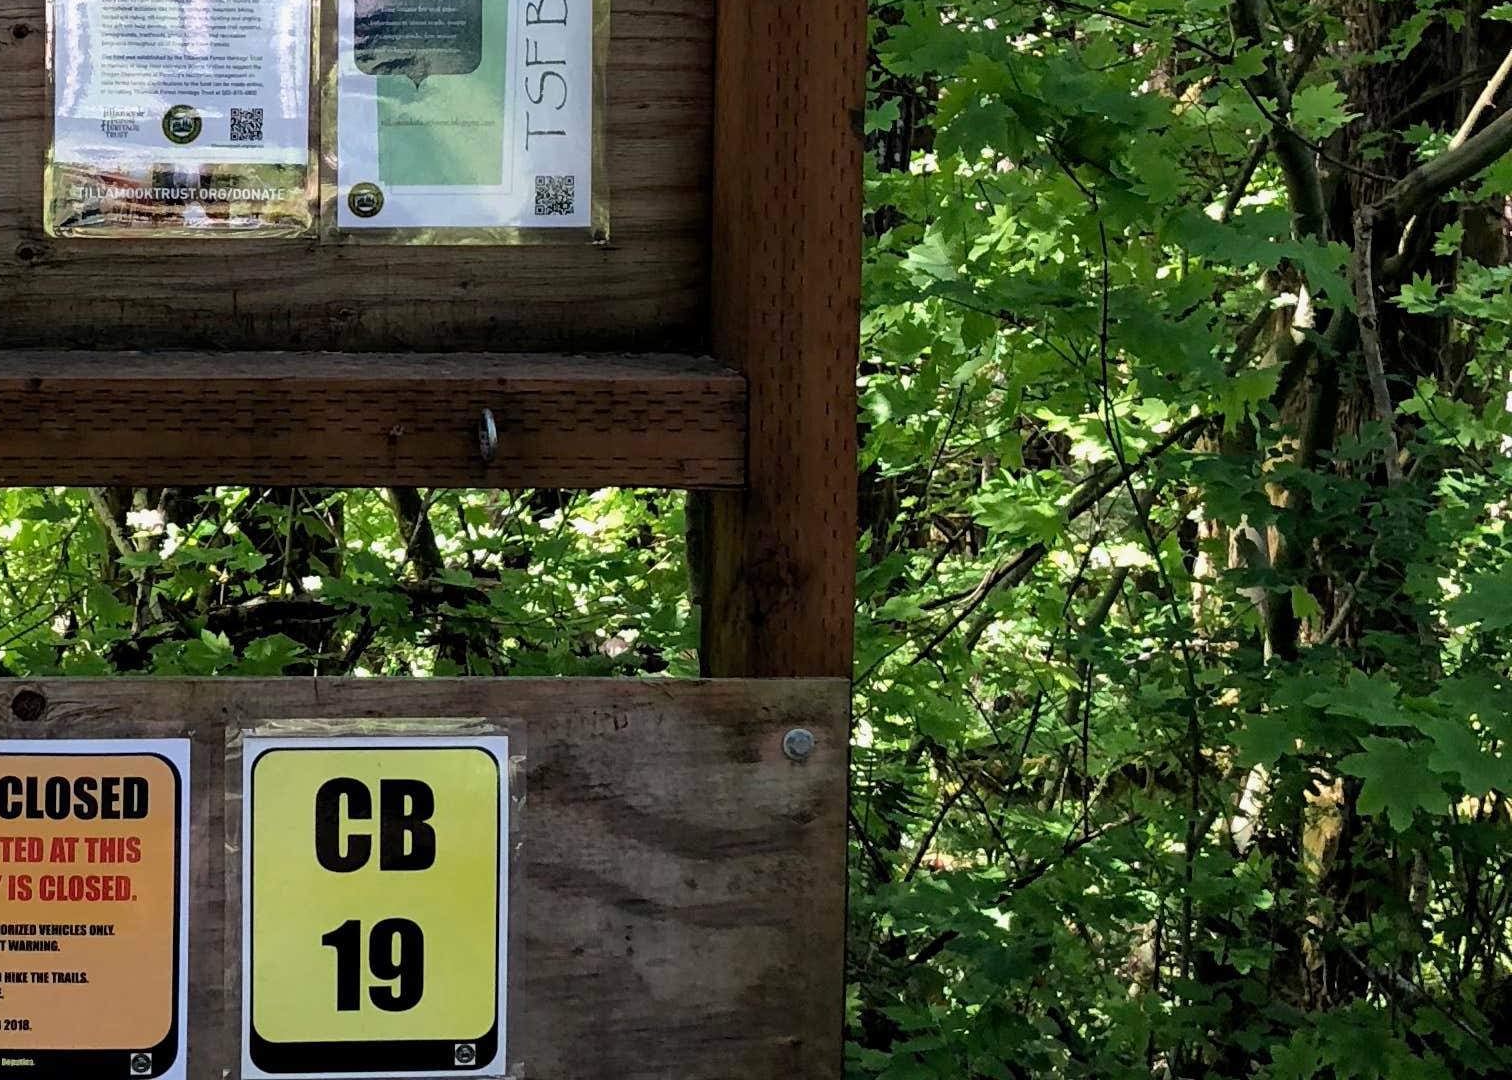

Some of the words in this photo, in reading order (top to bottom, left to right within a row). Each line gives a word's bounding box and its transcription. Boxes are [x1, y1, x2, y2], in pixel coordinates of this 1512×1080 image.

[525, 38, 568, 151] TSF
[49, 836, 79, 863] AT
[84, 836, 141, 863] THIS
[315, 777, 436, 873] CB
[8, 874, 32, 901] IS
[39, 874, 137, 902] CLOSED.
[321, 917, 425, 1012] 19
[3, 1019, 32, 1031] 2018.
